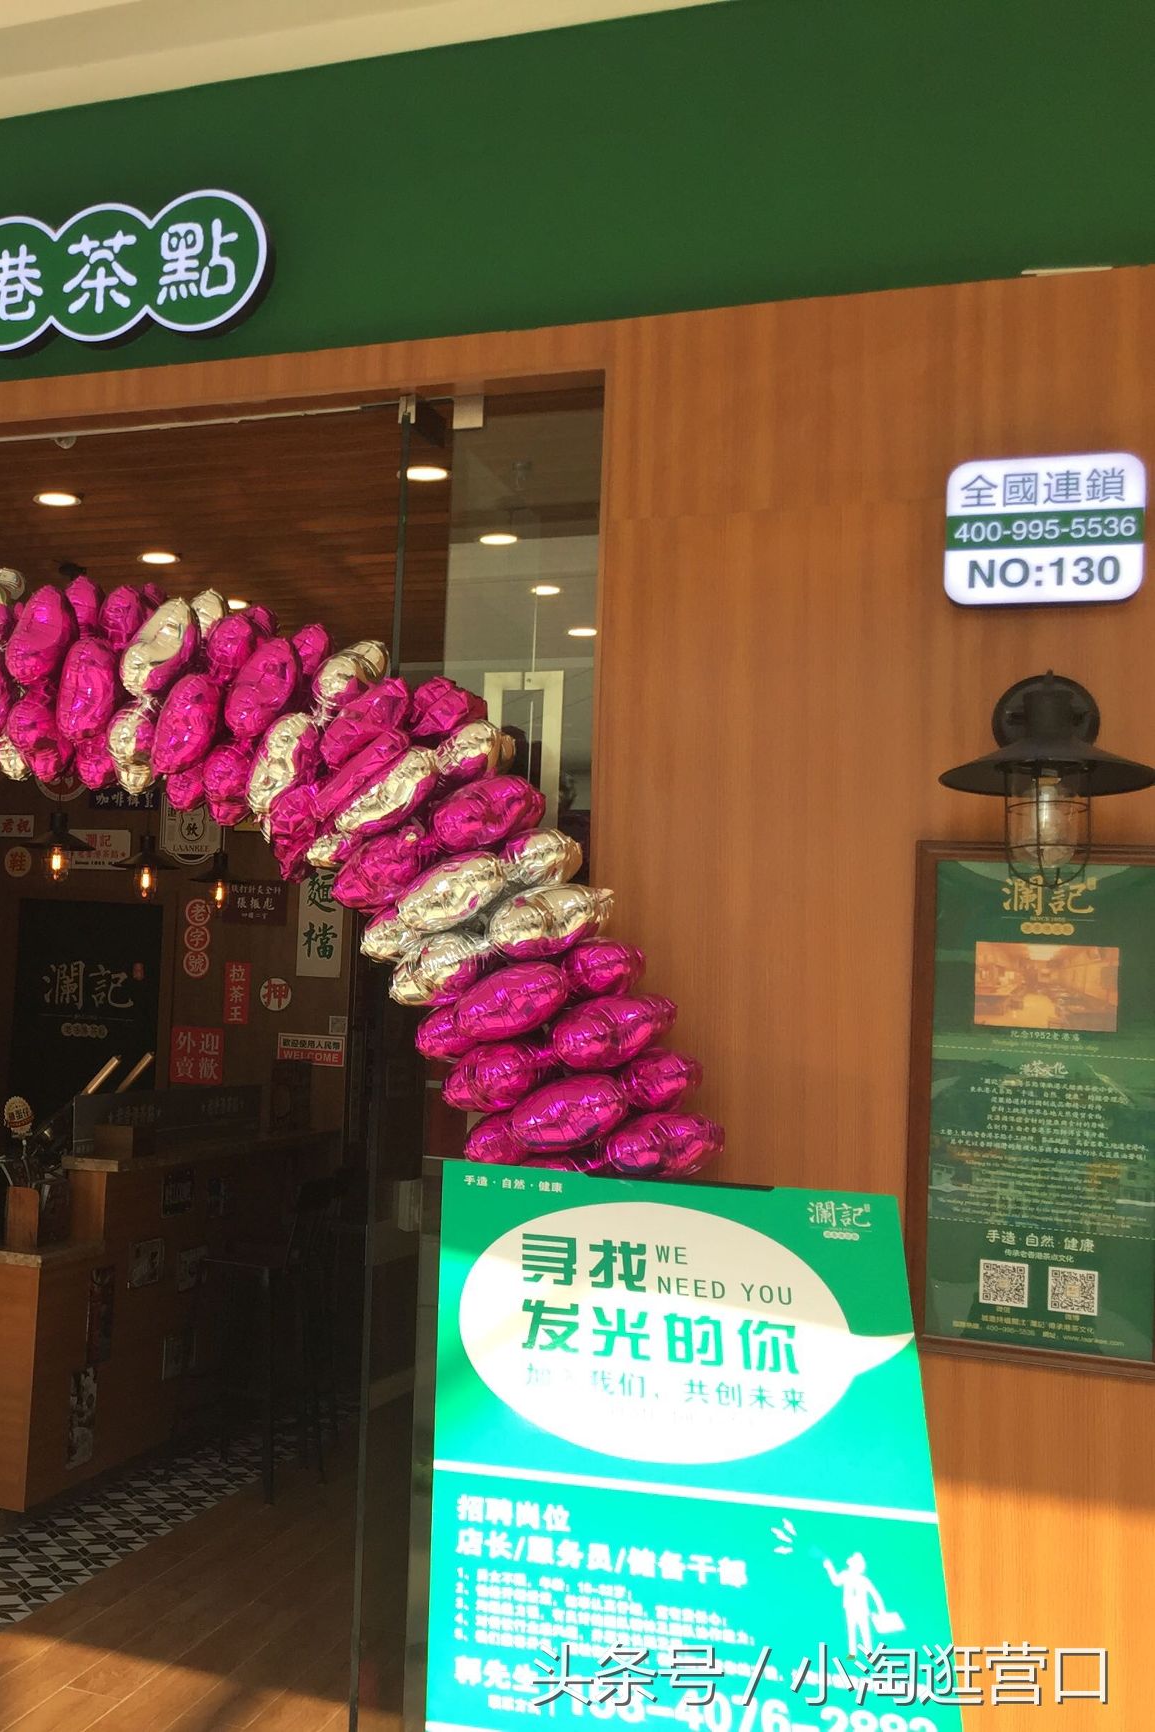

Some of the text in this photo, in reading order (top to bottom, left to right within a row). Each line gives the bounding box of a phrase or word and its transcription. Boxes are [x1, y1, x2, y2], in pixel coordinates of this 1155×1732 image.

[961, 468, 1125, 508] 全國連鎖
[954, 516, 1137, 543] 400-995-5536
[968, 556, 1121, 589] NO:130
[227, 964, 246, 1022] 拉茶王
[283, 1050, 339, 1063] WELCOME
[522, 1233, 647, 1294] 寻找
[656, 1244, 688, 1265] WE
[657, 1276, 793, 1306] NEED YOU
[522, 1298, 800, 1376] 发光的你
[526, 1361, 809, 1413] 加我们，共创未来
